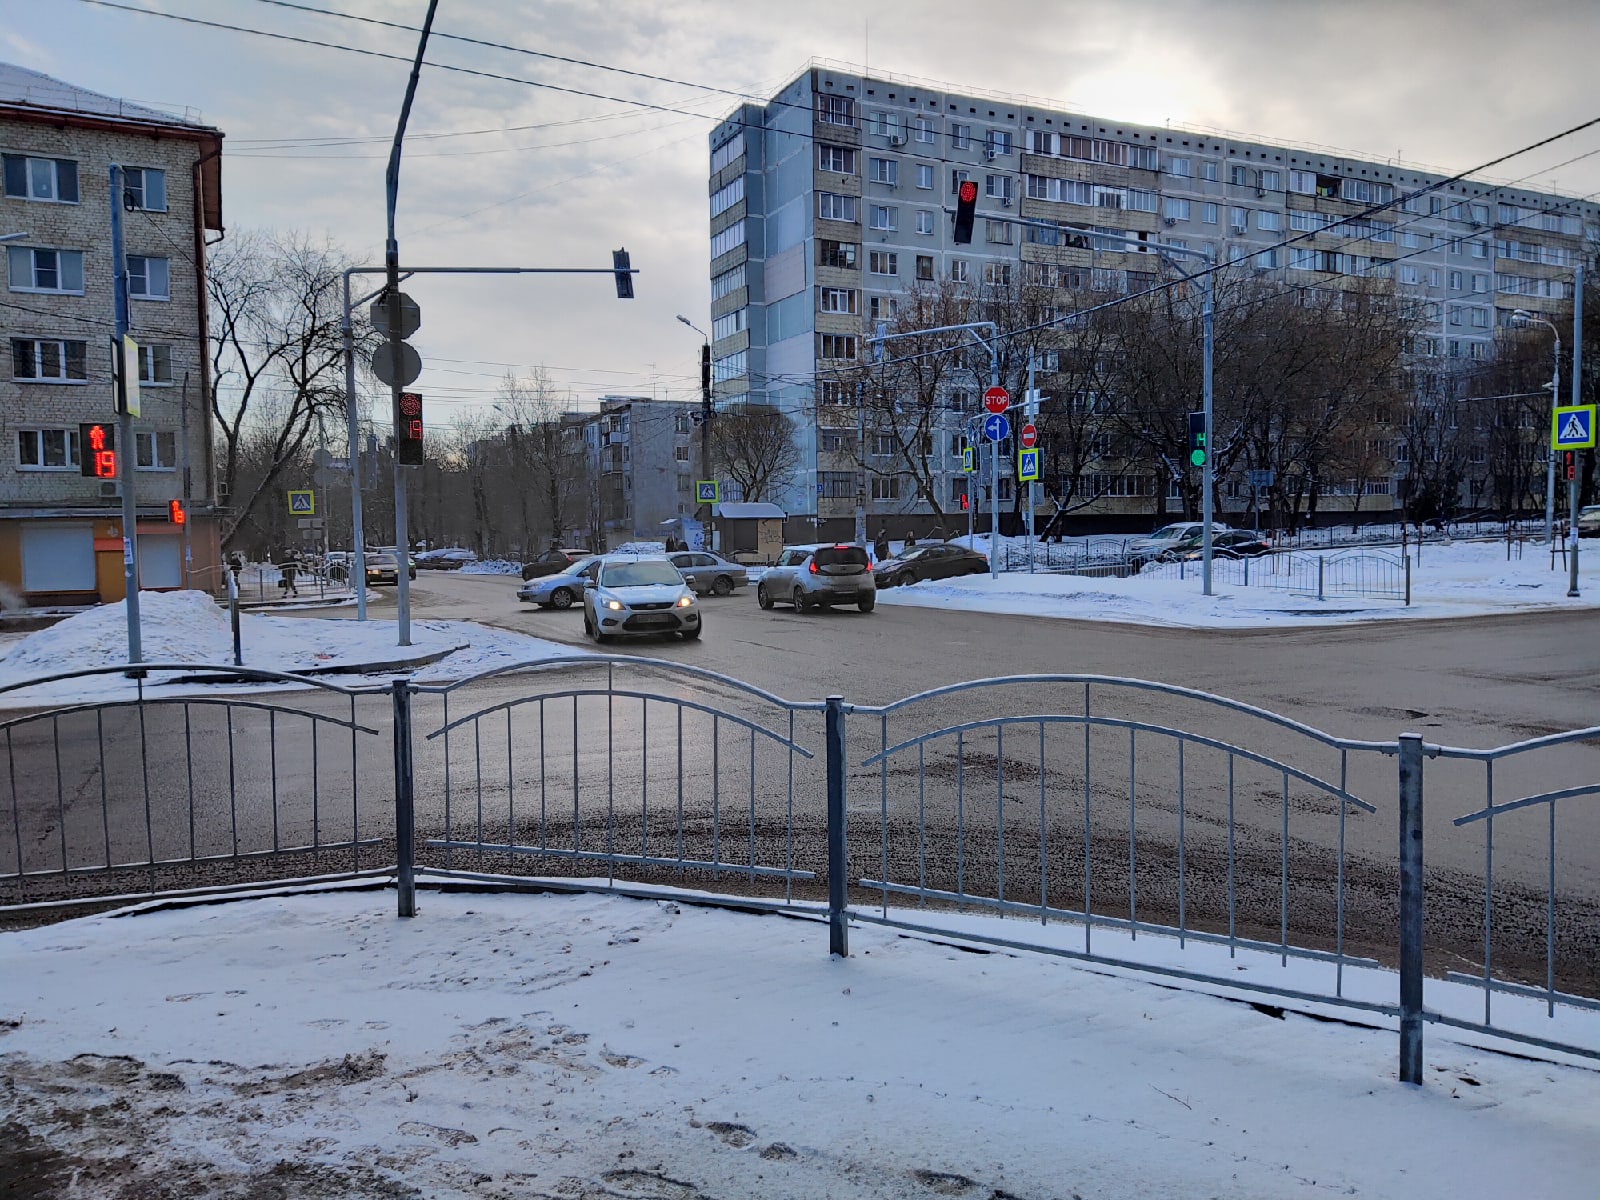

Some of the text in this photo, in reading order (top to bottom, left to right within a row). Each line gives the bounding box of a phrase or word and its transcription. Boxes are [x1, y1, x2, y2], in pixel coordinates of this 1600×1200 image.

[985, 396, 1007, 405] STOP
[409, 419, 422, 439] 19
[1197, 433, 1206, 446] 14
[95, 450, 115, 478] 19
